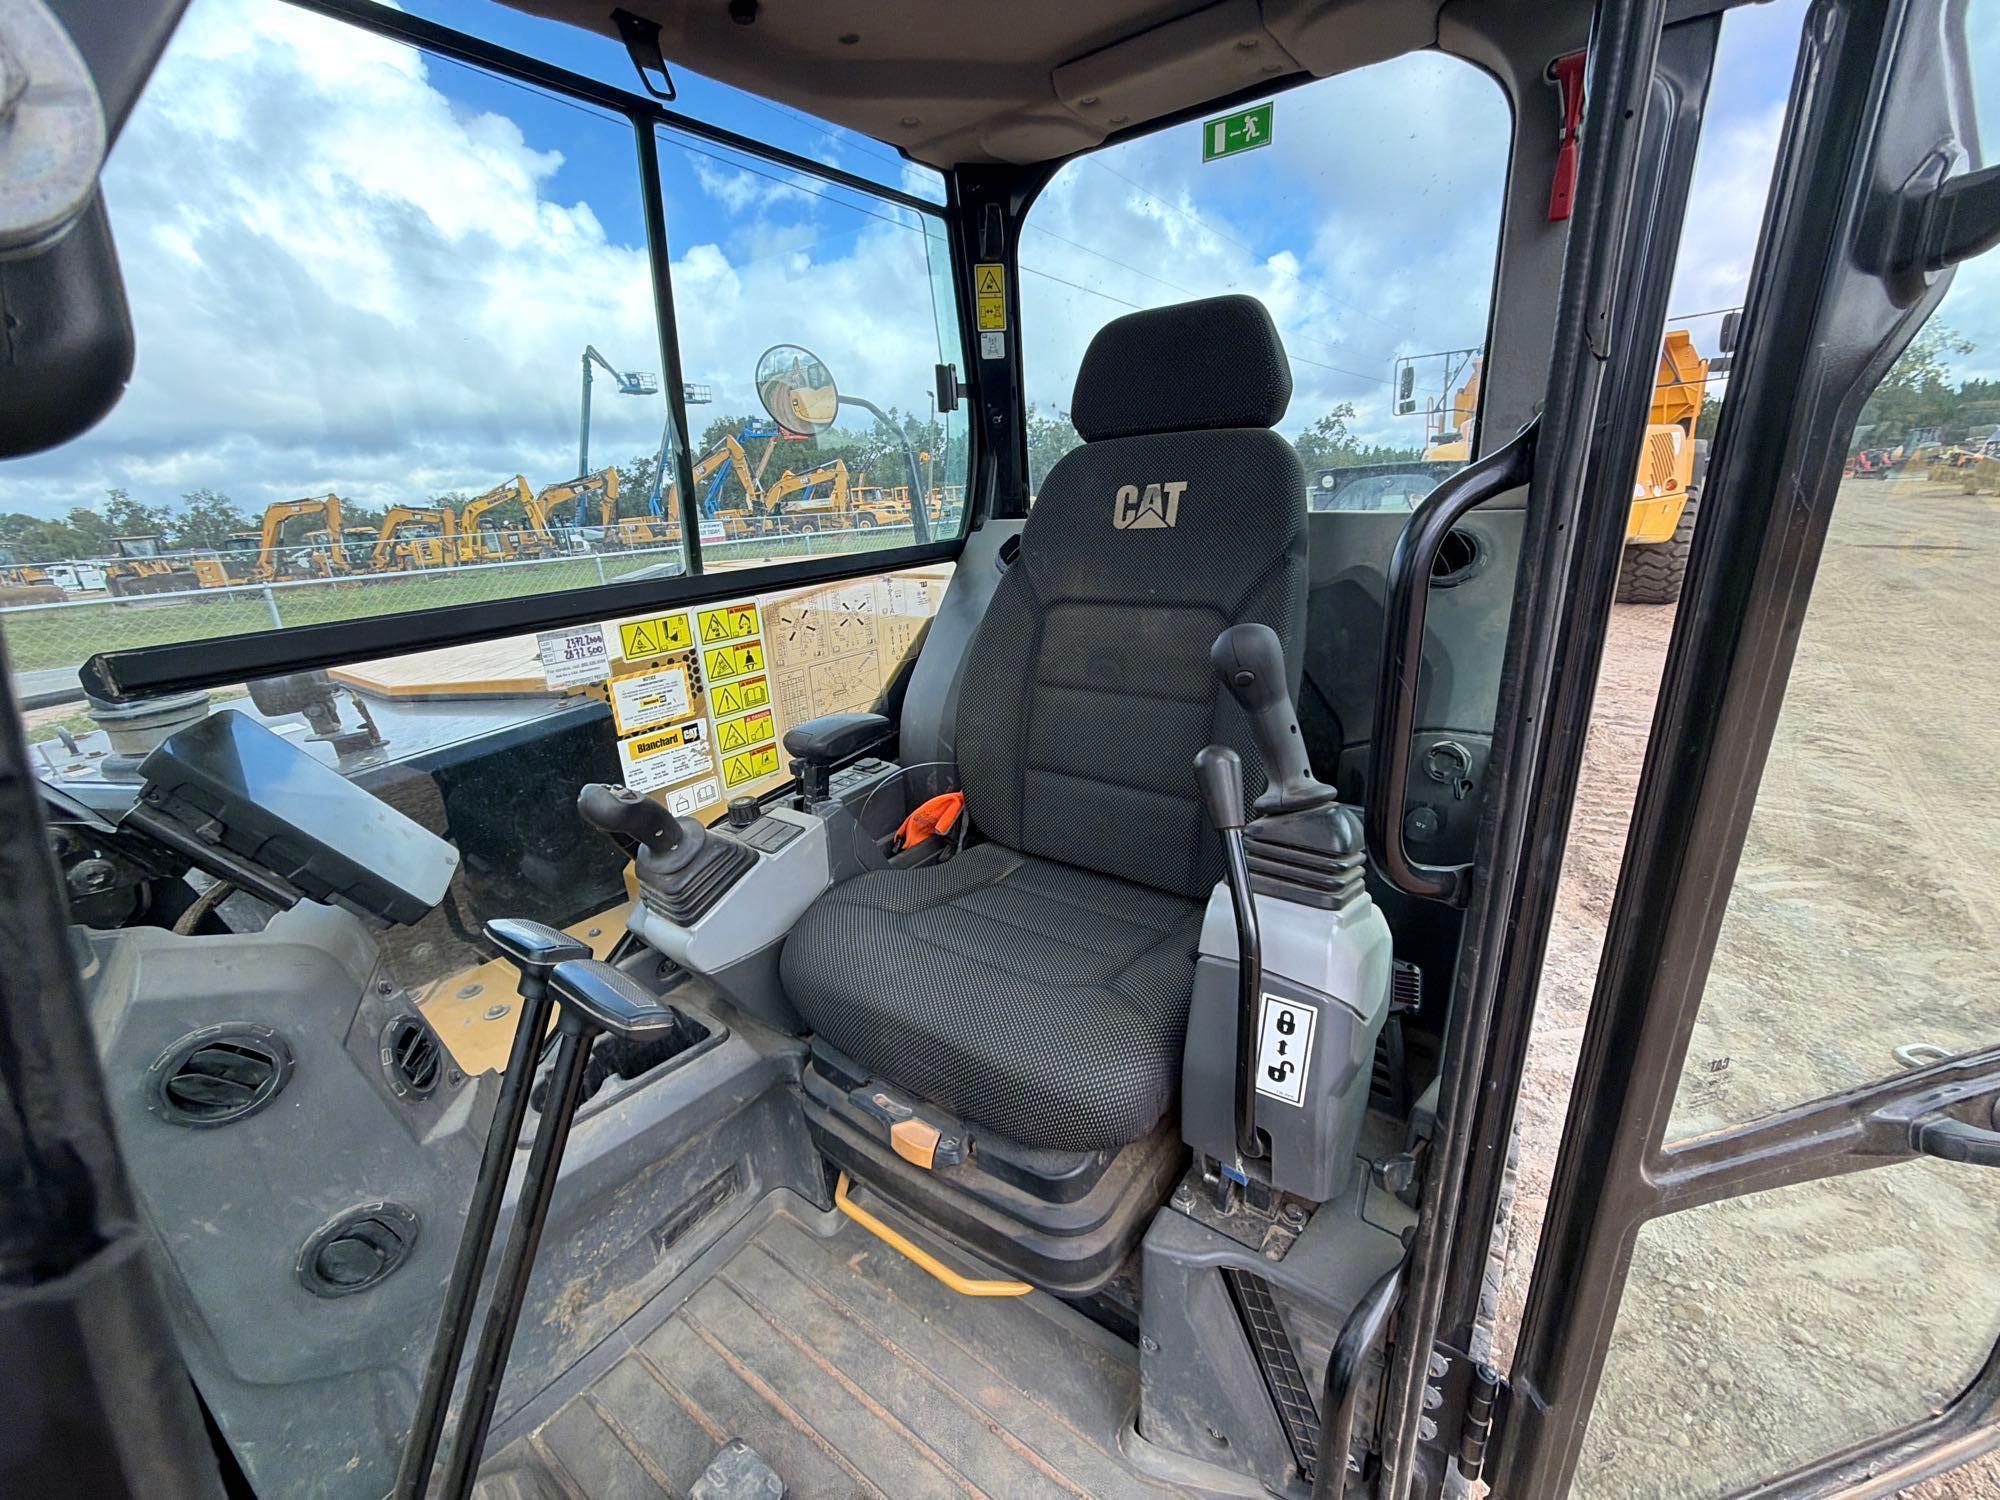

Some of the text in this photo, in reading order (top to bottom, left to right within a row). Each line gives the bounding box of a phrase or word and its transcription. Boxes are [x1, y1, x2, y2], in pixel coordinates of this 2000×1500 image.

[1112, 481, 1189, 530] CAT
[564, 645, 603, 660] 2872 500
[637, 727, 698, 753] Blanchard CAT
